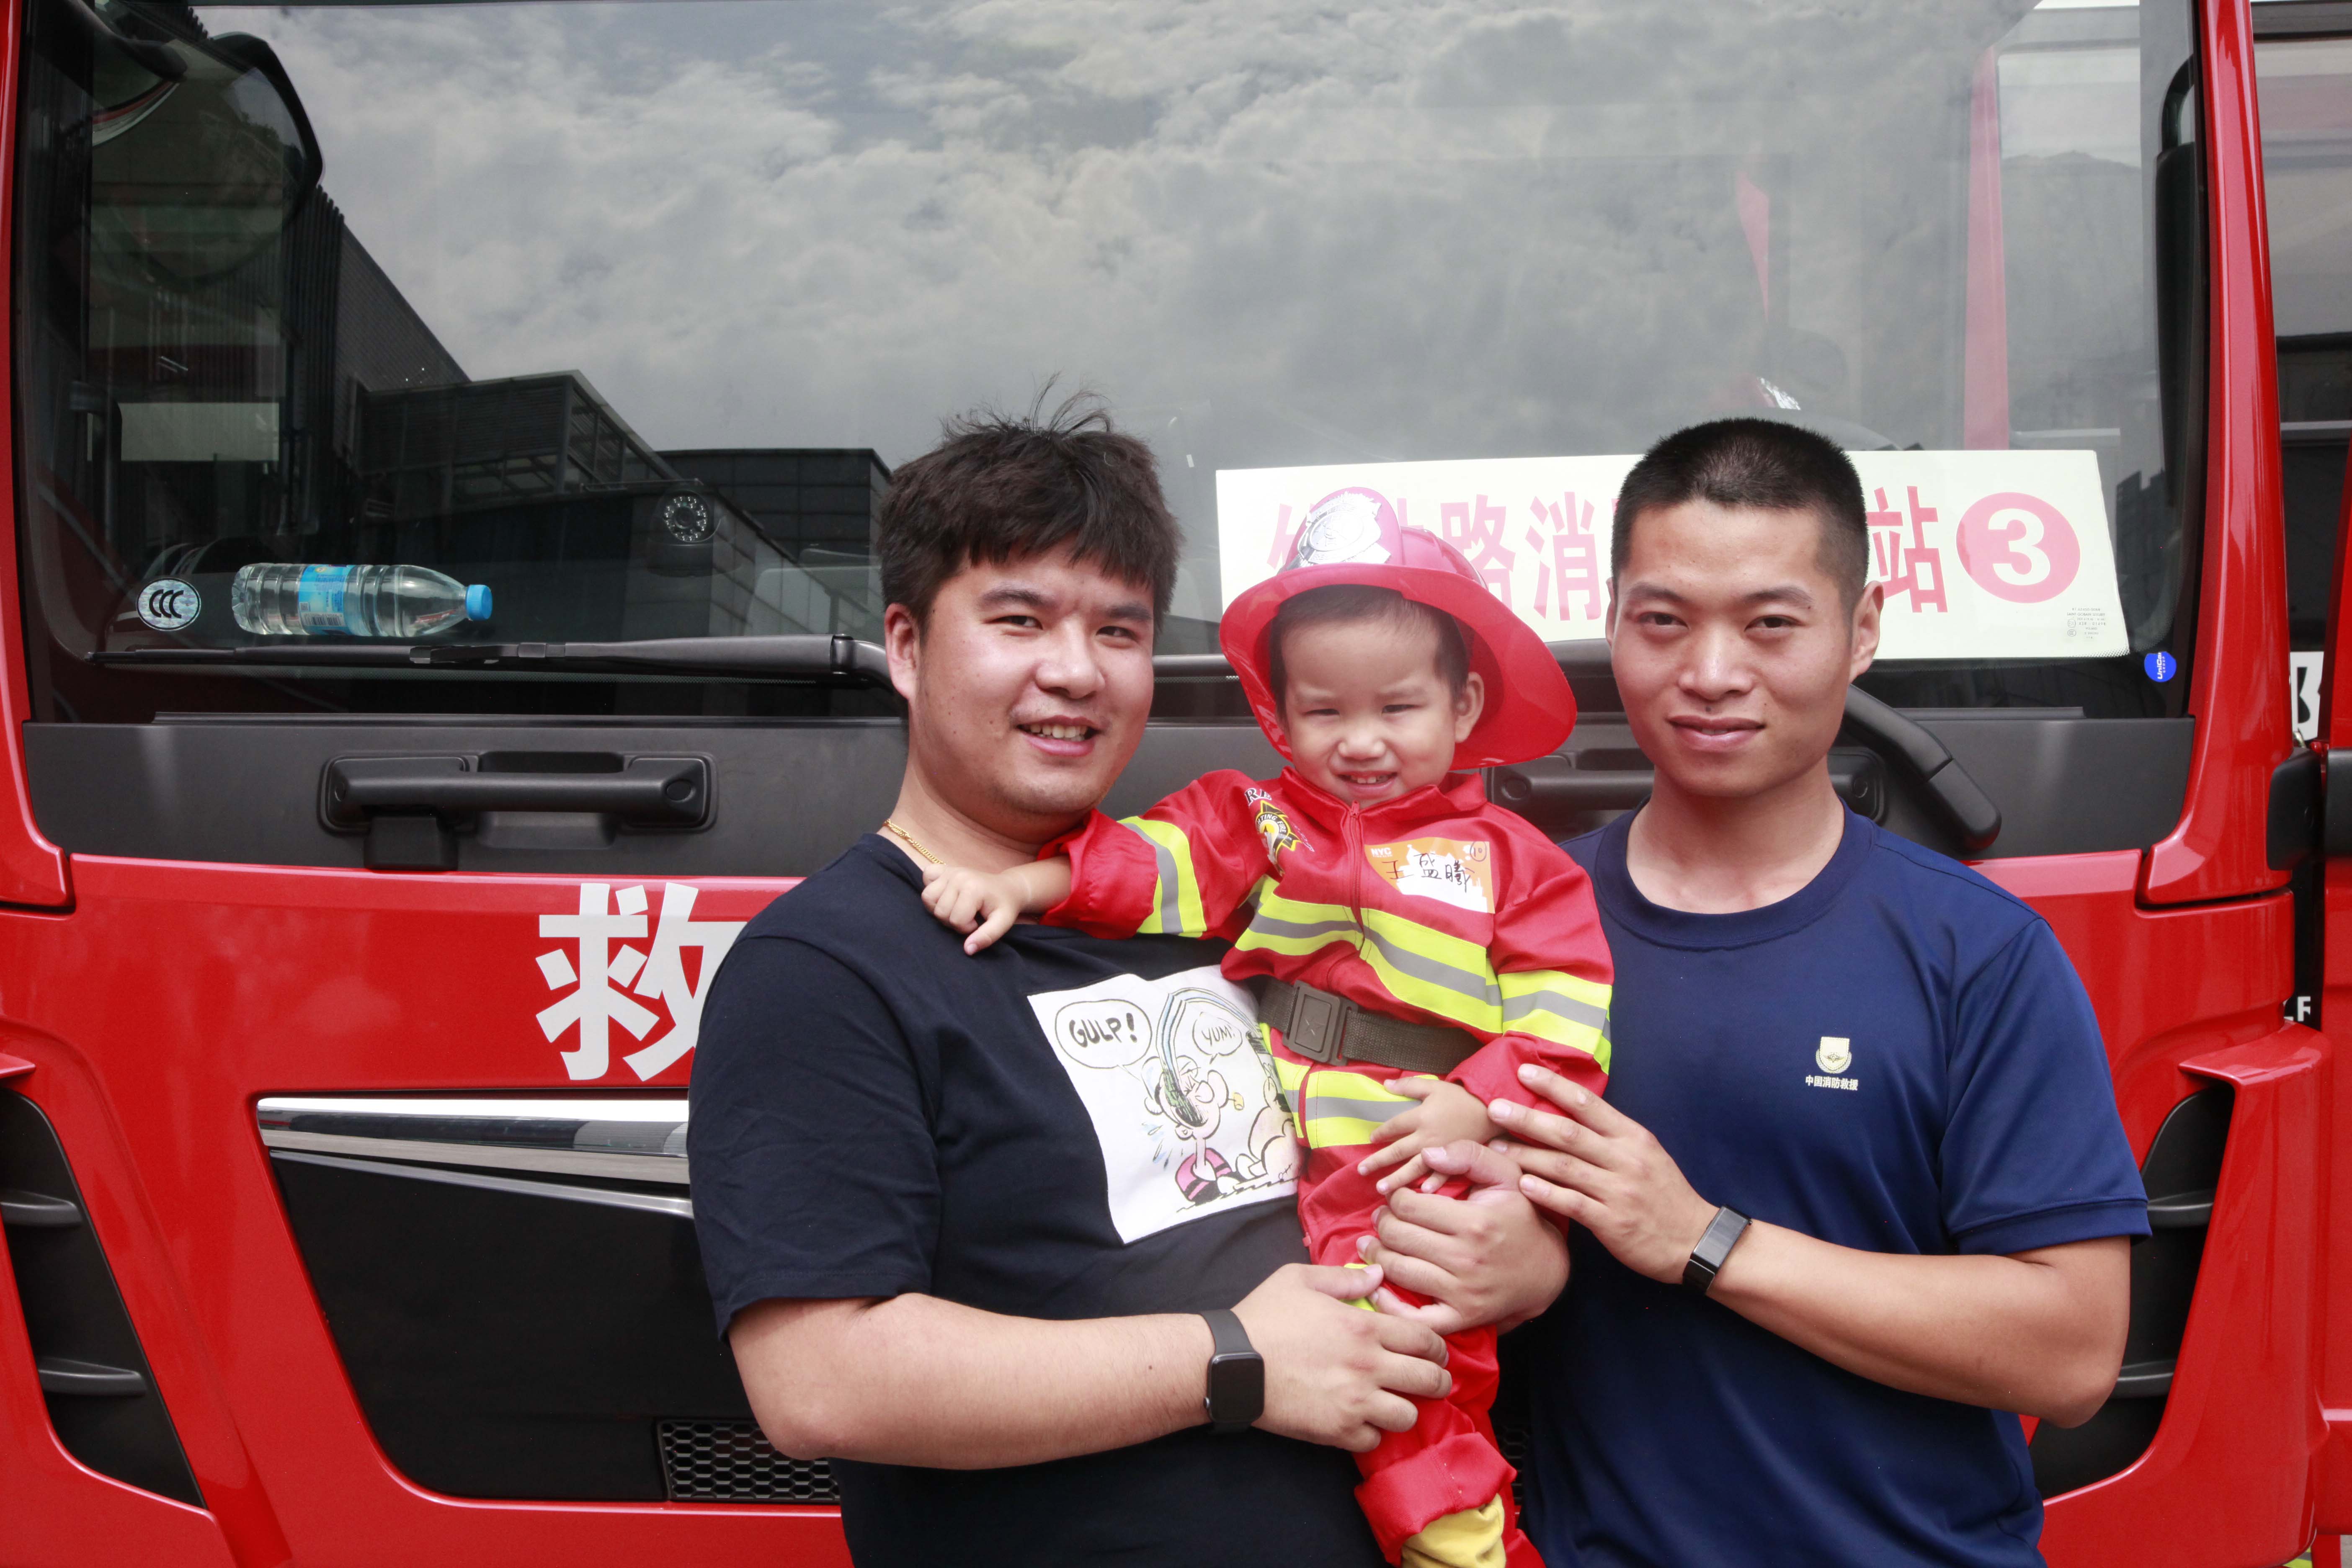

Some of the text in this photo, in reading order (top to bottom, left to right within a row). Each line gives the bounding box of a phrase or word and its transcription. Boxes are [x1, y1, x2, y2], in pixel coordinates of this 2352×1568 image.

[1370, 847, 1392, 856] NYC
[1069, 1012, 1137, 1048] GULP!
[1805, 1075, 1859, 1091] 中国消防救援
